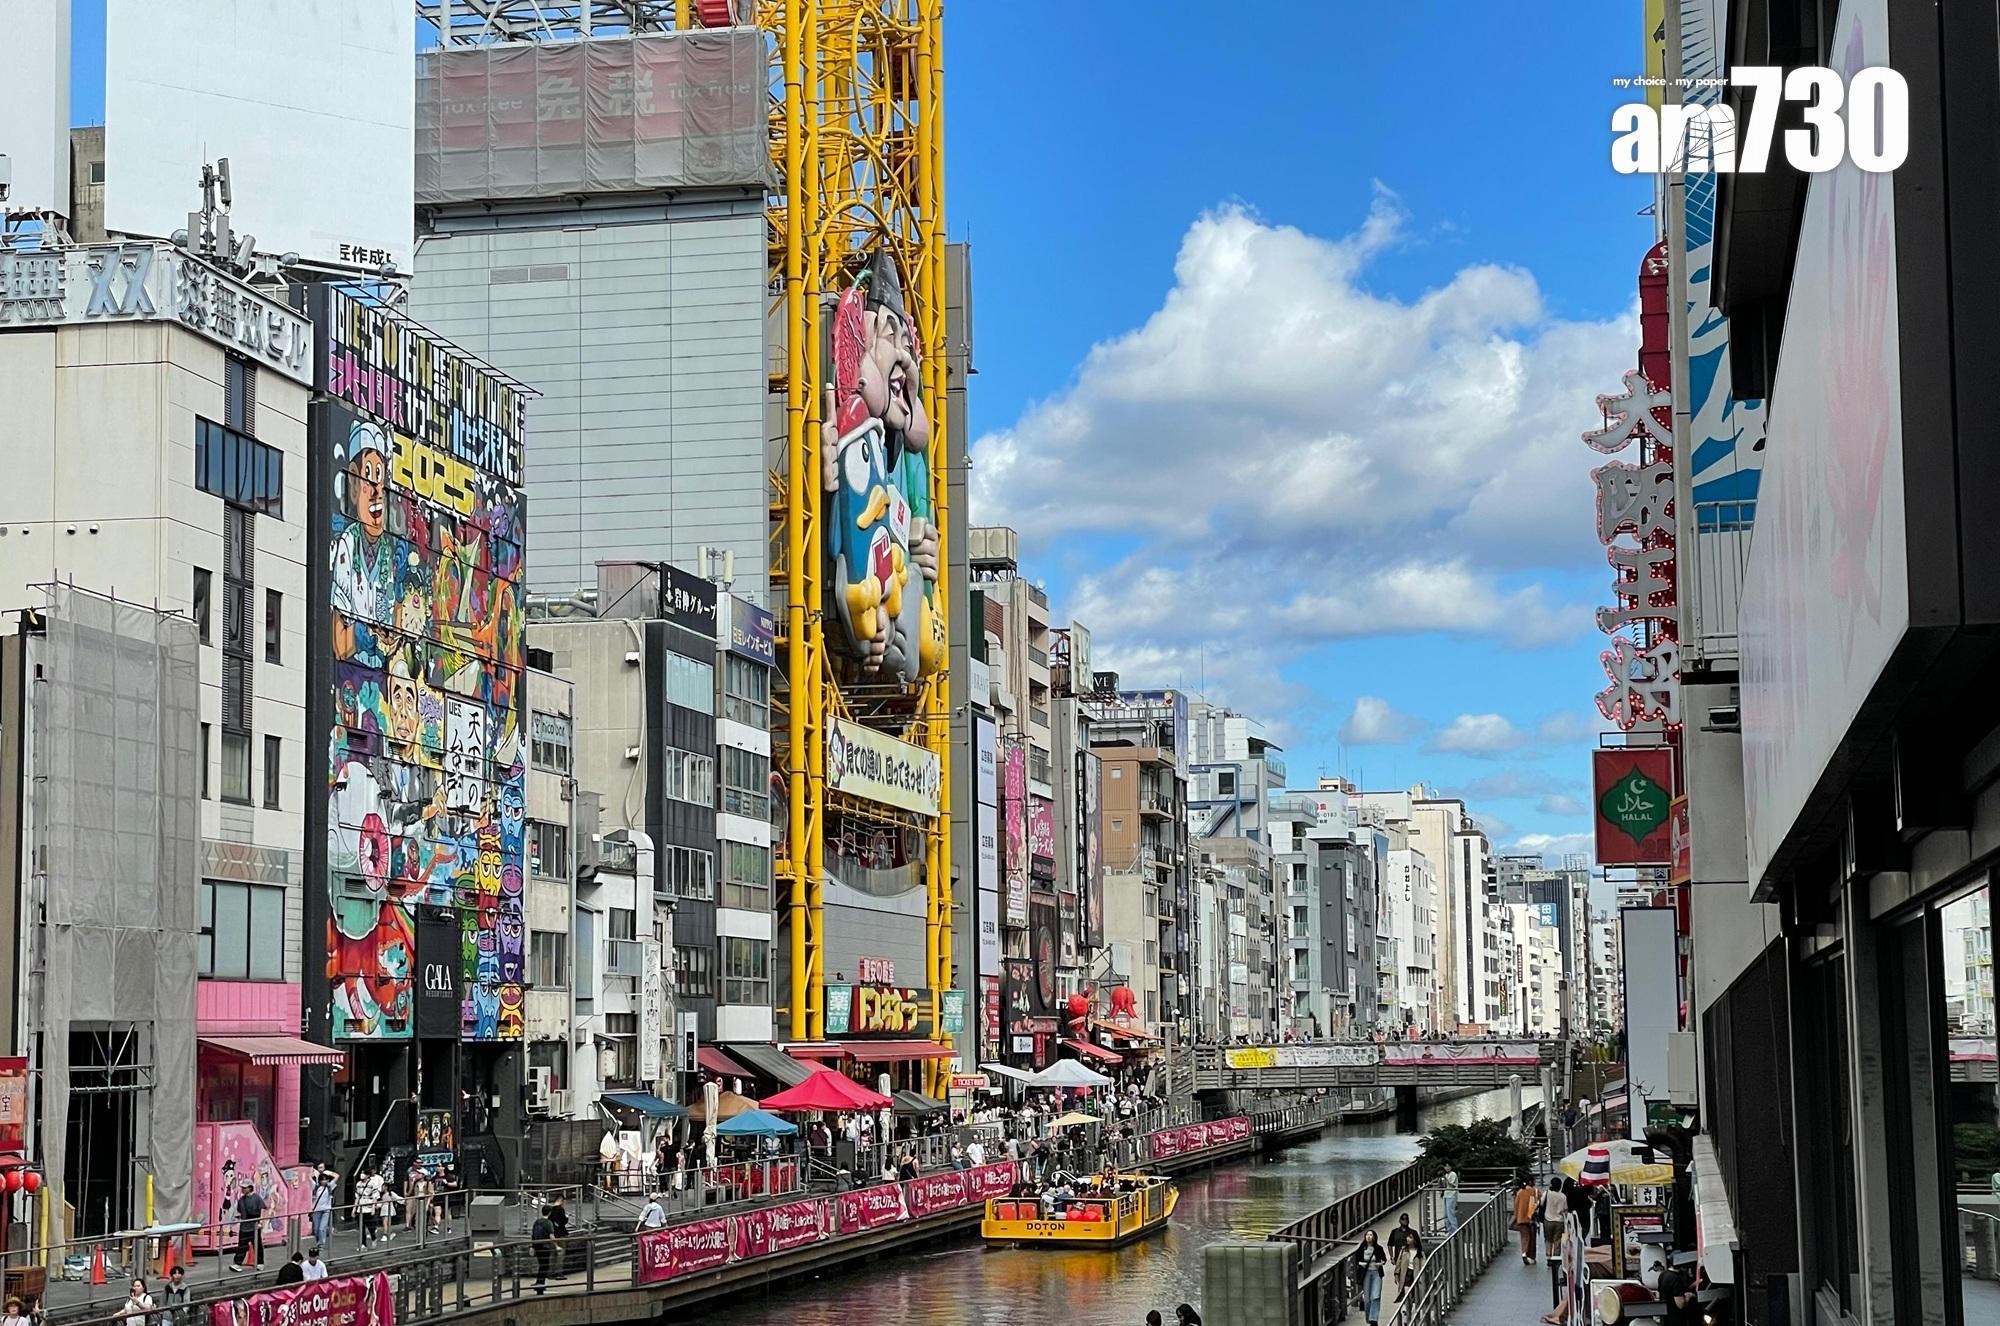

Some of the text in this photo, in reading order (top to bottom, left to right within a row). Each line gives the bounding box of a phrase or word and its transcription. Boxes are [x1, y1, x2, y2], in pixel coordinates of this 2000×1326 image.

[392, 432, 476, 517] 2025
[1581, 368, 1682, 730] 大阪王将
[1617, 792, 1655, 813] حلال
[1621, 813, 1653, 821] HALAL
[425, 963, 453, 991] GALA
[1027, 1222, 1065, 1231] DOTON
